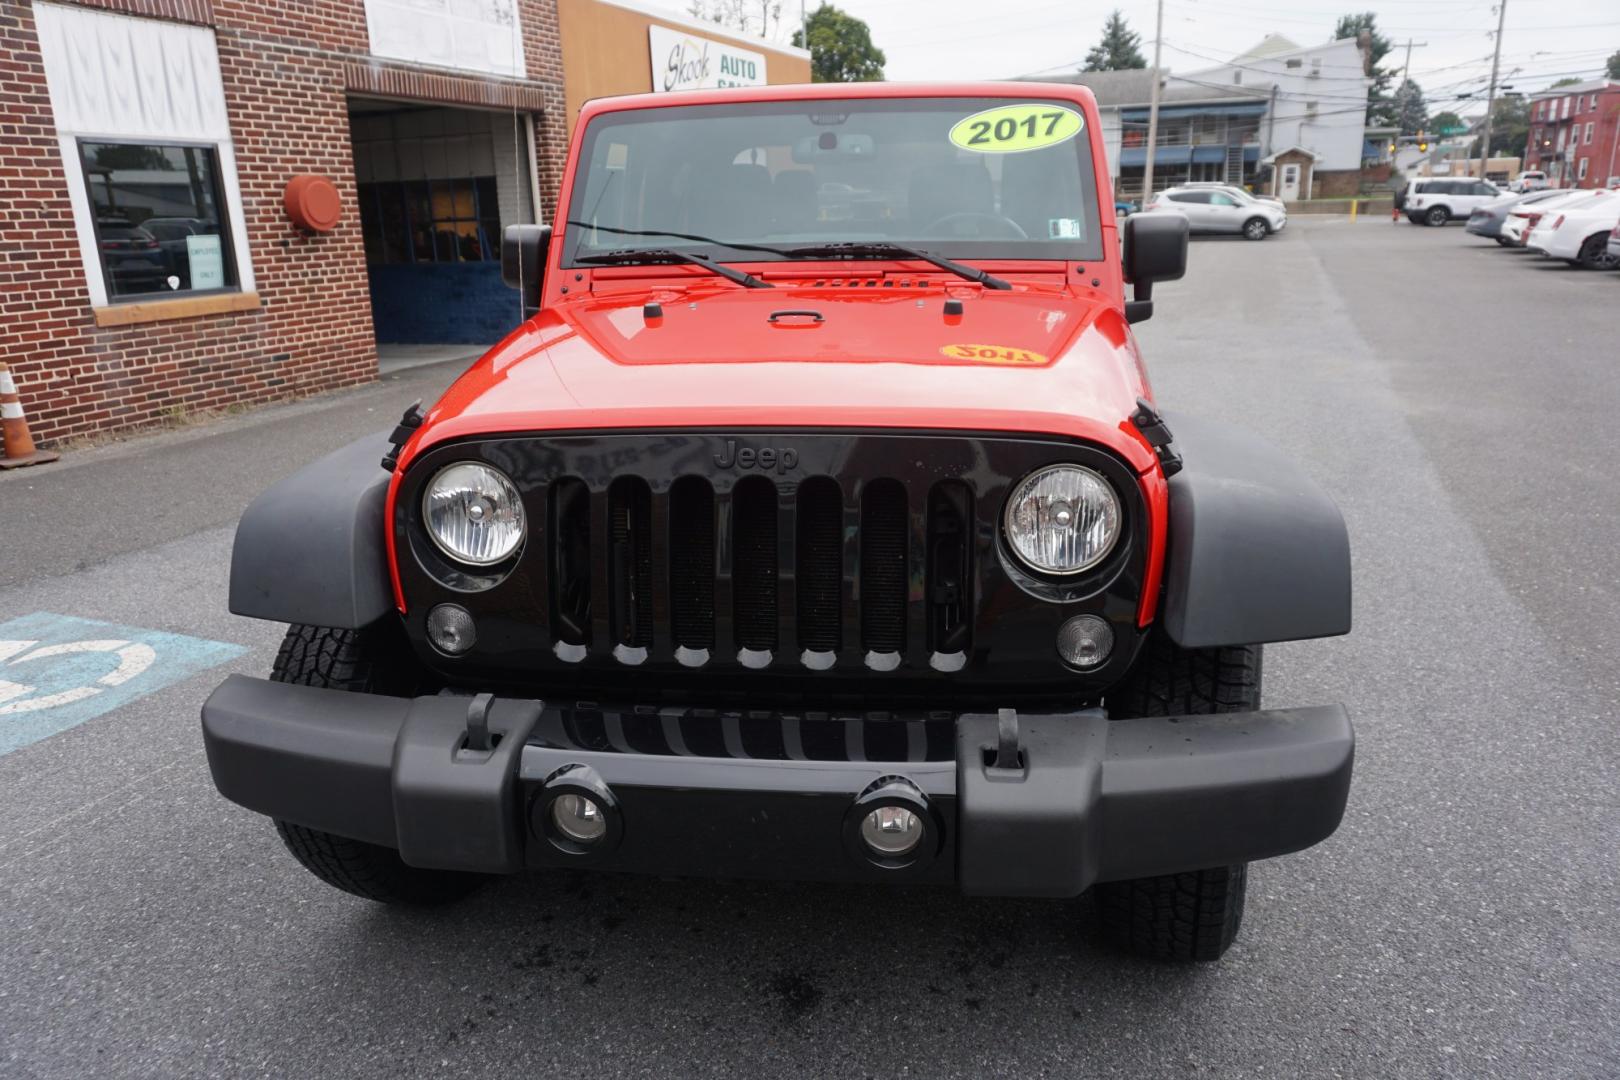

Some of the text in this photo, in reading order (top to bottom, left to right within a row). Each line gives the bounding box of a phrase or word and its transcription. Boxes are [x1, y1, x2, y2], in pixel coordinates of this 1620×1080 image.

[720, 53, 756, 80] AUTO
[967, 111, 1065, 146] 2017
[713, 440, 798, 475] Jeep
